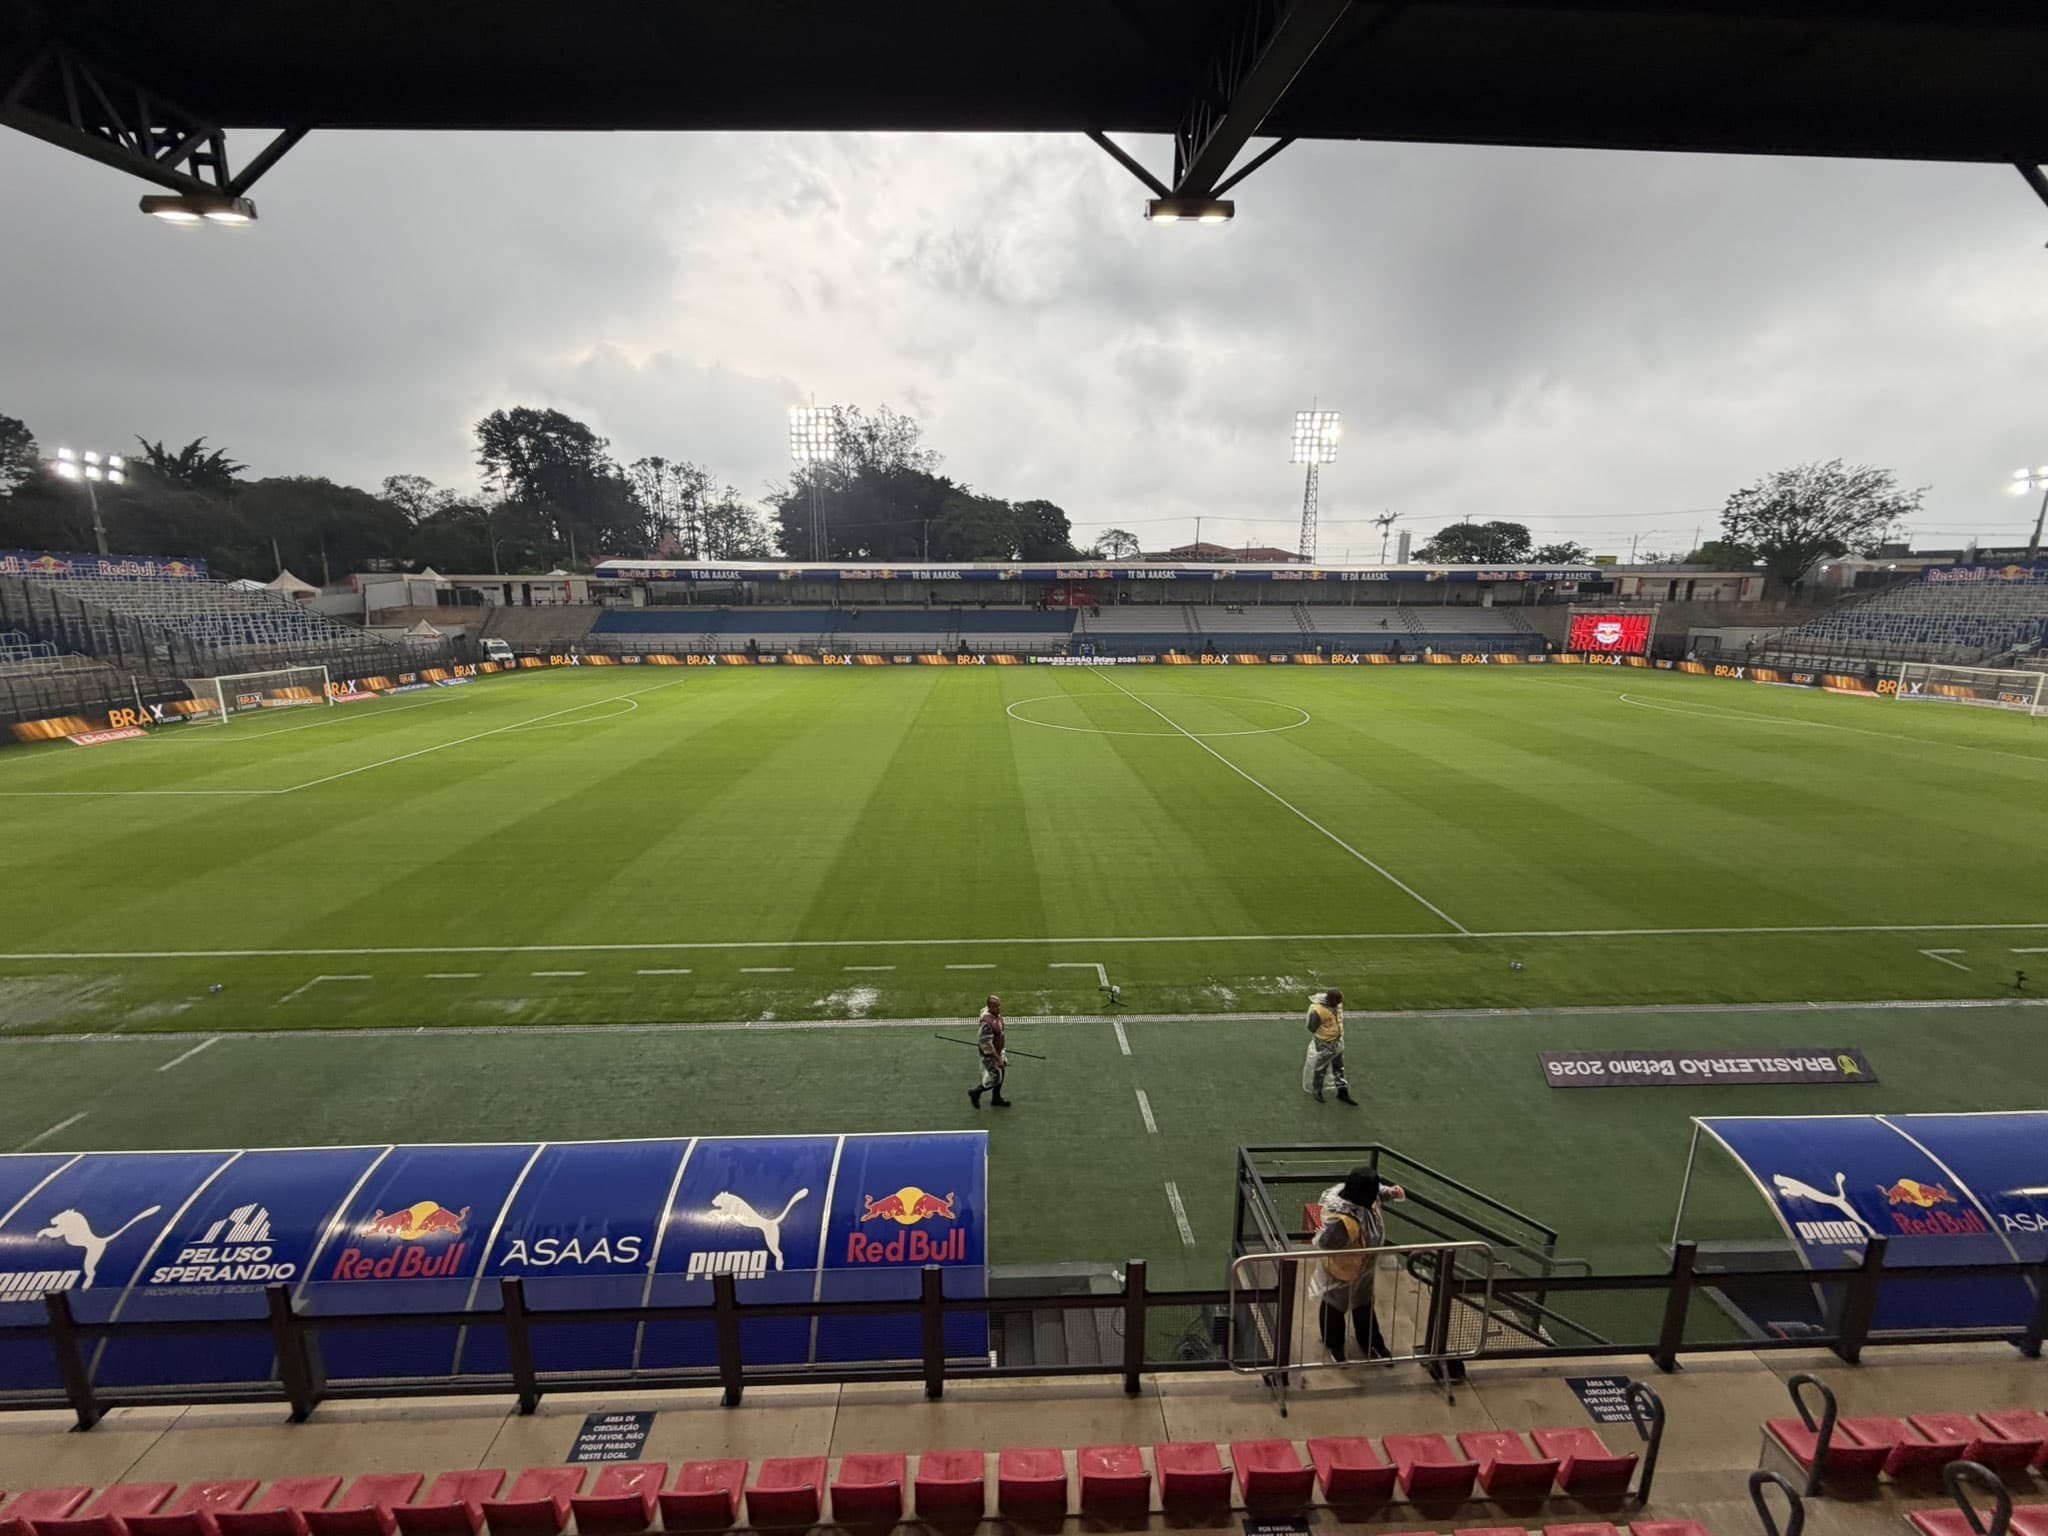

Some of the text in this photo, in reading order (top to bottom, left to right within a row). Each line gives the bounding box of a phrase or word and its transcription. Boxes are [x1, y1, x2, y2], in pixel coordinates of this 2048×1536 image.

[0, 557, 18, 573] ull
[550, 655, 579, 666] BRAX
[687, 655, 716, 665] BRAX
[823, 655, 851, 665] BRAX
[957, 655, 986, 665] BRAX
[1201, 654, 1229, 664] BRAX
[1332, 654, 1359, 664] BRAX
[1461, 654, 1488, 664] BRAX
[1589, 655, 1622, 665] BRAX
[453, 664, 477, 677] BRAX
[1714, 664, 1745, 679] BRAX
[1877, 679, 1922, 694] BRAX
[108, 704, 163, 729] BRAX
[1548, 1056, 1837, 1077] BRASILEIRÃO Betano 2026
[1893, 1208, 1987, 1234] Red Bull
[500, 1236, 642, 1267] ASAAS
[847, 1228, 965, 1264] Red Bull
[176, 1246, 272, 1264] PELUSO
[332, 1243, 466, 1281] Red Bull
[686, 1250, 768, 1281] PUMA
[150, 1263, 296, 1283] SPERANDIO
[593, 1423, 640, 1432] CIRCULAÇÃO
[626, 1432, 645, 1440] NÃO
[605, 1442, 636, 1450] PARADO
